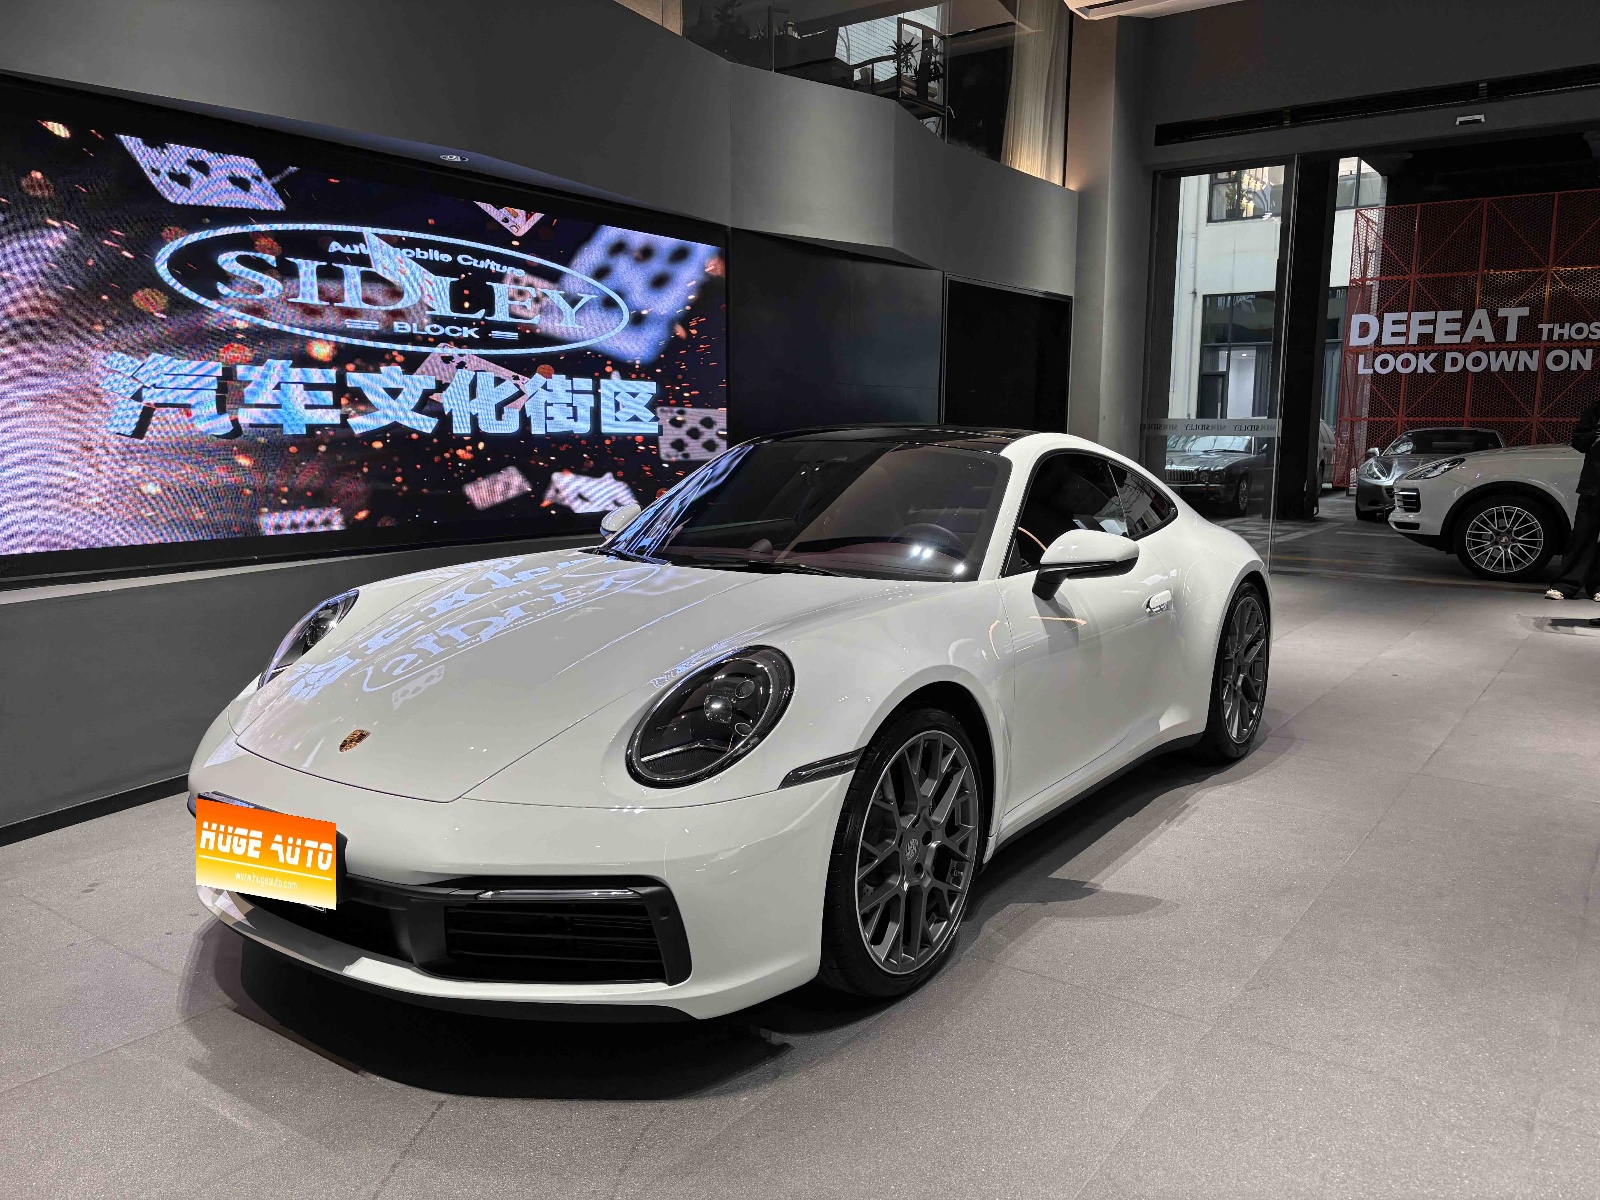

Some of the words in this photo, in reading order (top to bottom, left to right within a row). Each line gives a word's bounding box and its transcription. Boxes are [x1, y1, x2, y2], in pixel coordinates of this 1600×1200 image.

[456, 254, 526, 277] Culture
[216, 249, 599, 331] SIDLEY
[393, 321, 480, 340] BLOCK
[1349, 307, 1530, 346] DEFEAT
[1357, 352, 1439, 375] LOOK
[1444, 350, 1540, 373] DOWN
[1545, 349, 1593, 372] ON
[98, 352, 661, 437] 汽车文化街区
